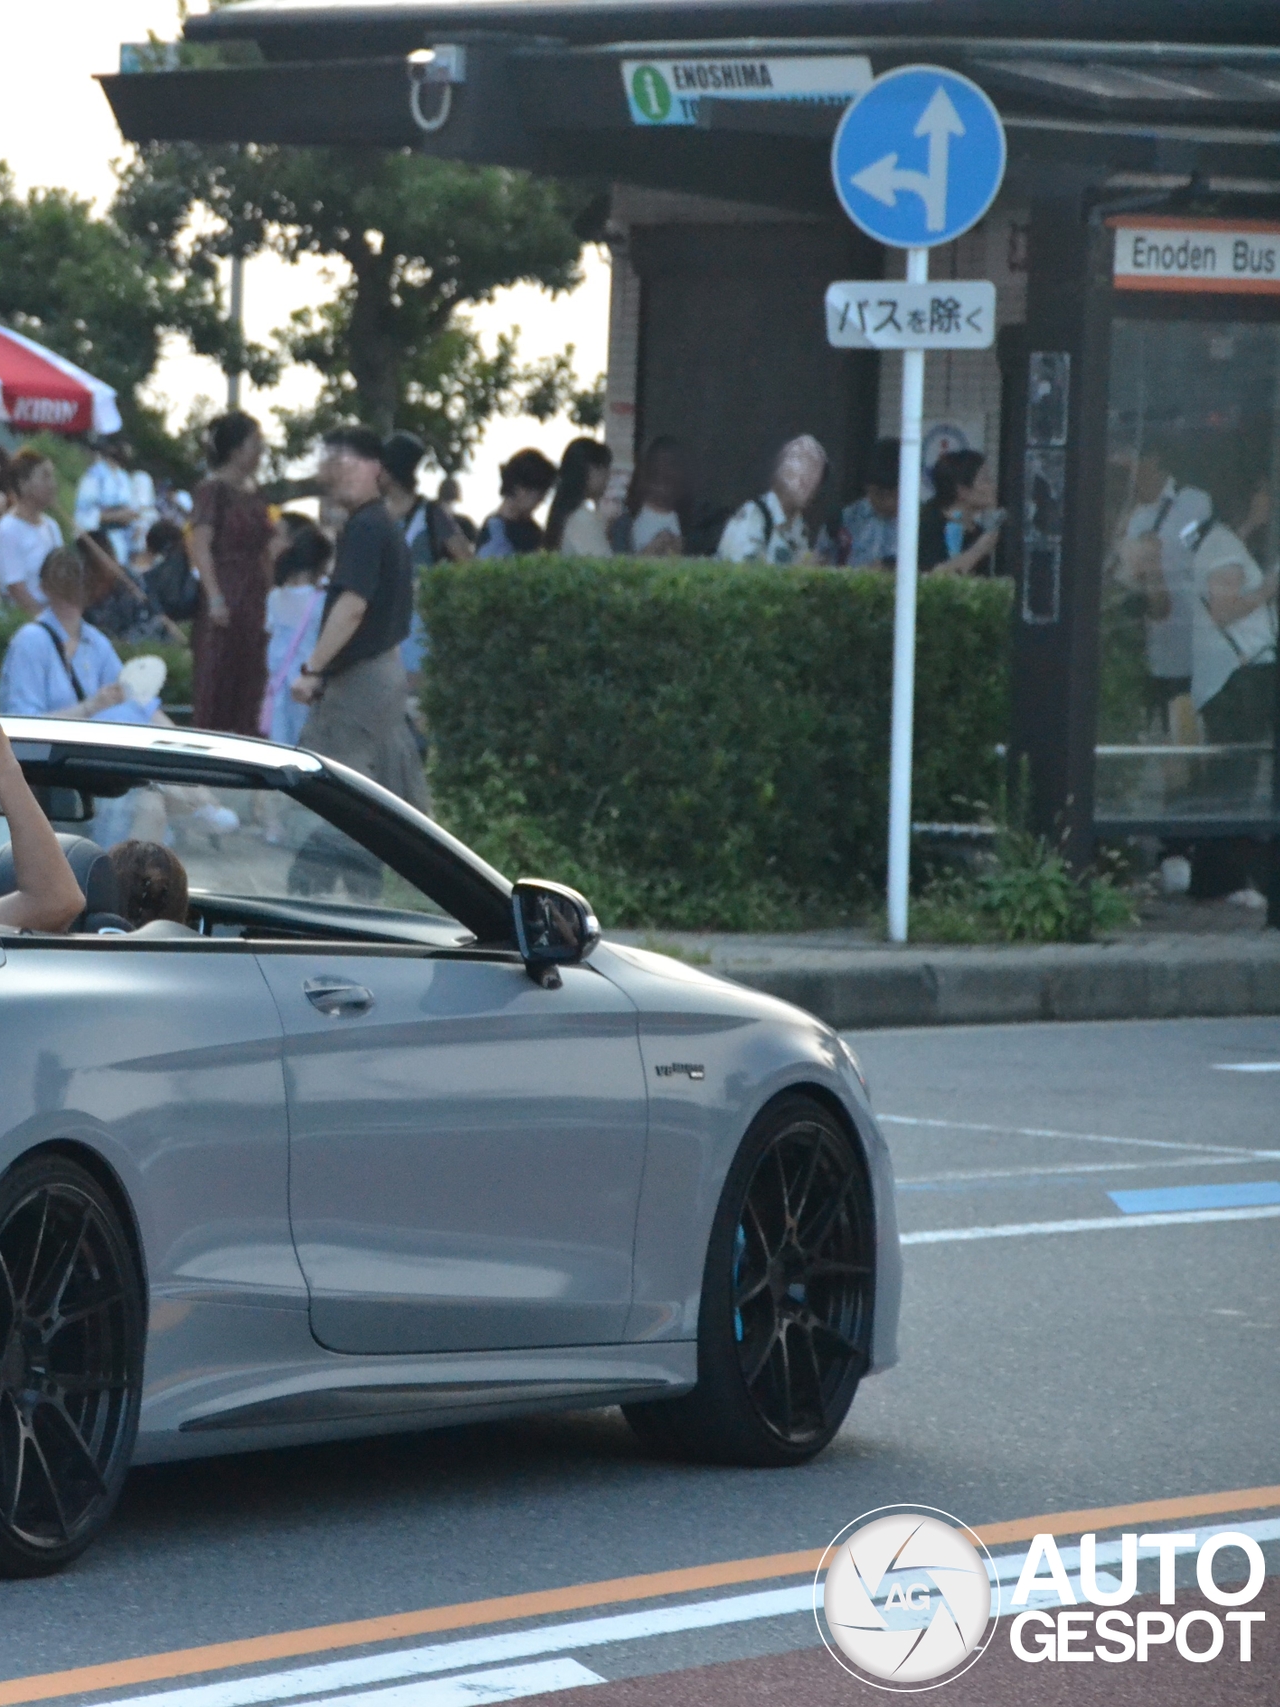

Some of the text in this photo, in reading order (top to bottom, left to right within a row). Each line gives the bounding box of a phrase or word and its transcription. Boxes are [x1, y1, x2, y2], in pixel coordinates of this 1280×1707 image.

[673, 62, 773, 91] ENOSHIMA
[1132, 235, 1276, 274] Enoden Bus
[838, 296, 983, 334] バスを除く
